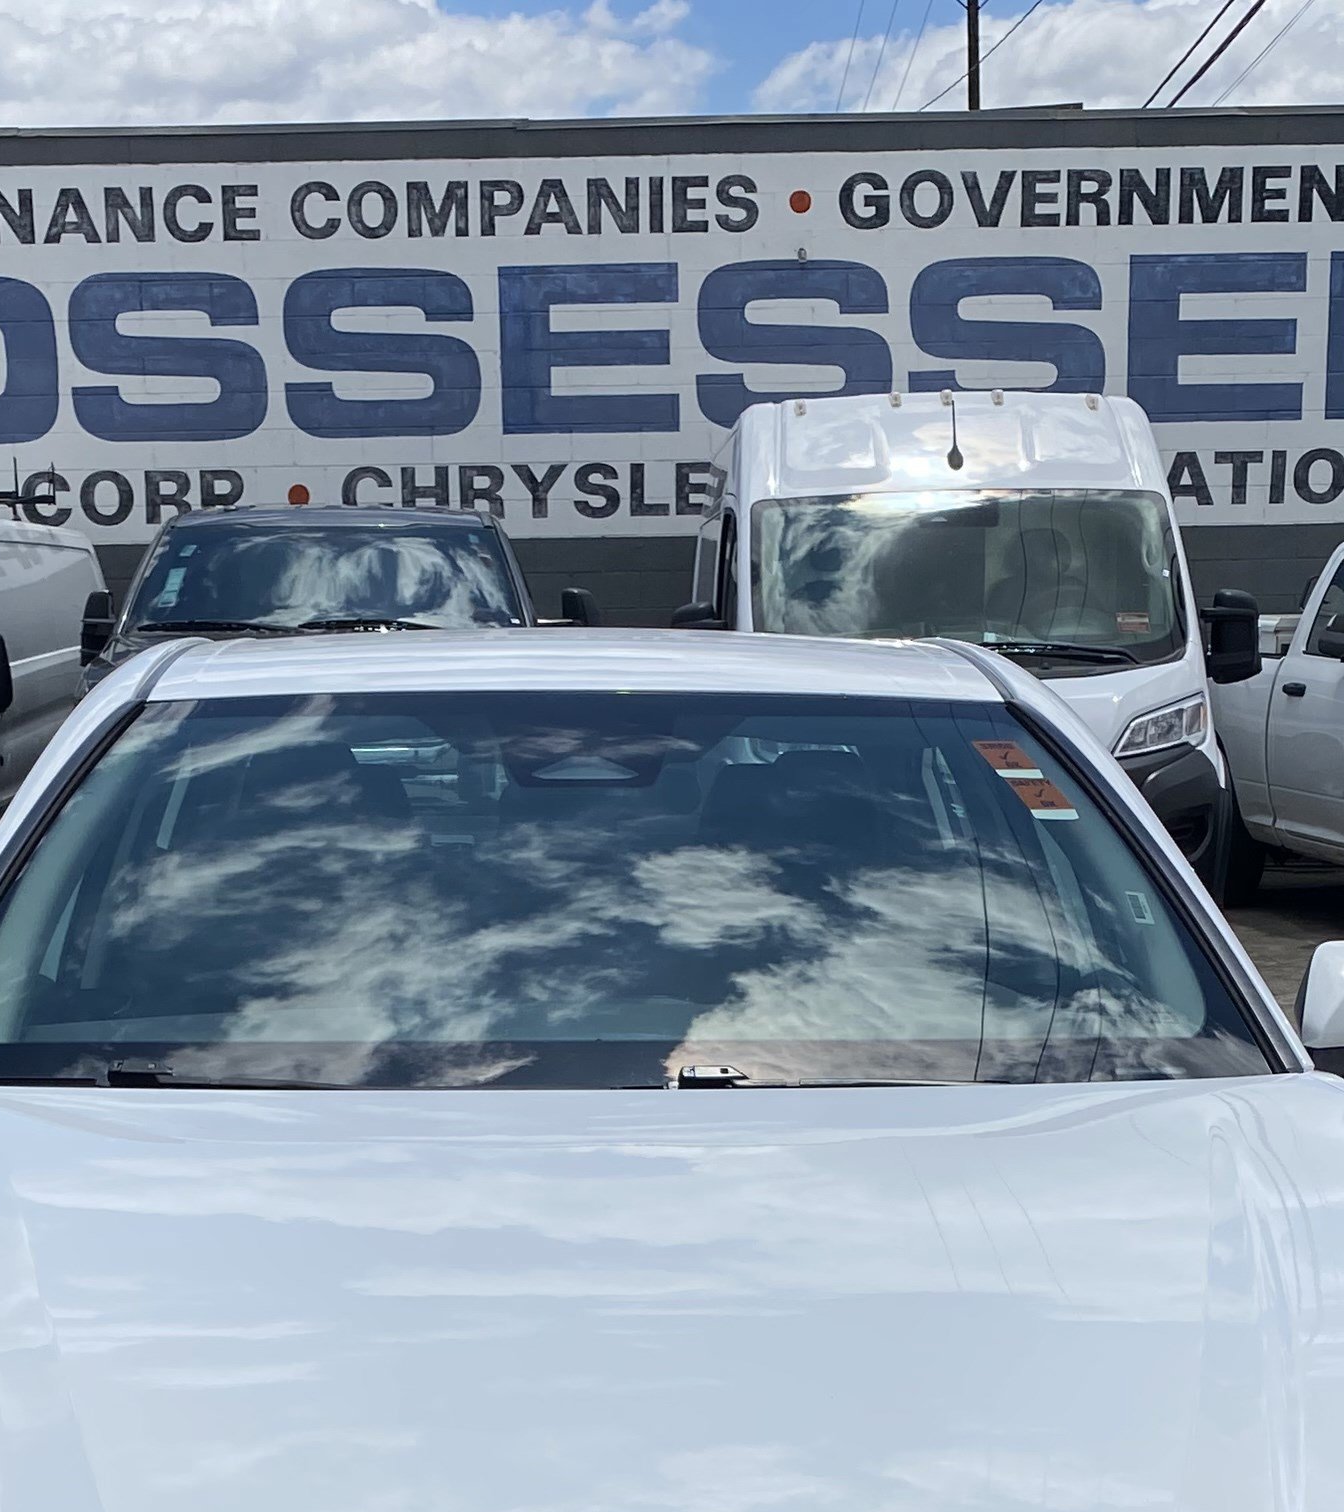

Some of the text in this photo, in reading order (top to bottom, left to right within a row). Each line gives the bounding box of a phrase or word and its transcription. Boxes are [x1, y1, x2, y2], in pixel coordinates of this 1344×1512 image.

[290, 174, 760, 240] COMPANIES
[21, 469, 245, 527] CORP
[341, 462, 716, 520] CHRYSLE
